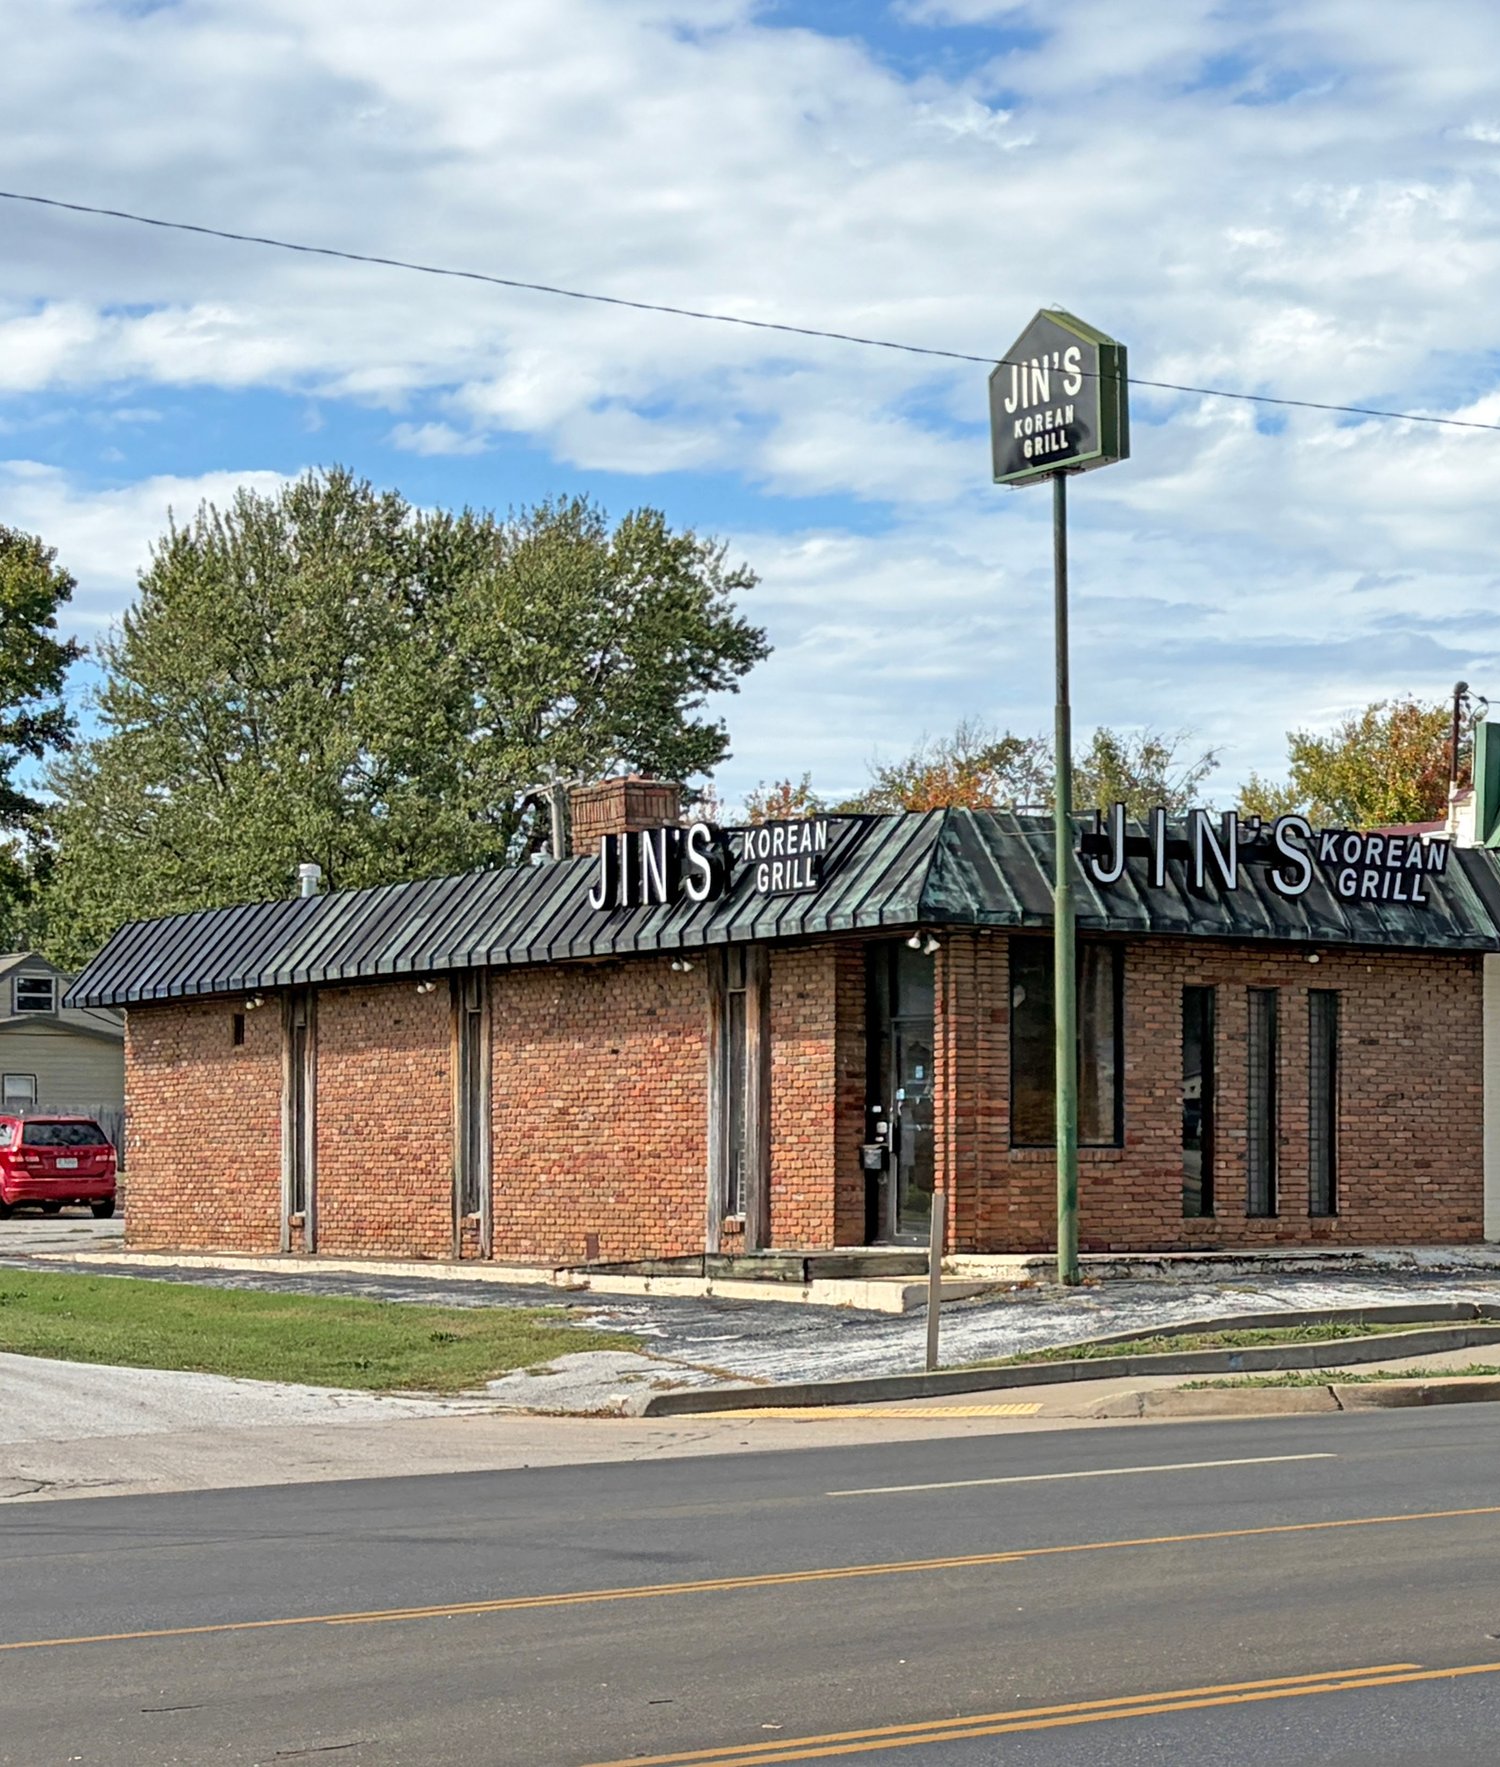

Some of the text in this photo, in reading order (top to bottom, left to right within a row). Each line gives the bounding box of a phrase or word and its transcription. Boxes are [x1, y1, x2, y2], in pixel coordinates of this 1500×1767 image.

[1004, 346, 1083, 414] JIN'S
[1014, 404, 1074, 438] KOREAN
[1023, 430, 1069, 458] GRILL
[743, 820, 828, 860] KOREAN
[1091, 803, 1312, 895] JIN'S
[1320, 833, 1445, 871] KOREAN
[589, 823, 711, 910] JIN'S
[756, 857, 816, 893] GRILL
[1338, 867, 1426, 902] GRILL
